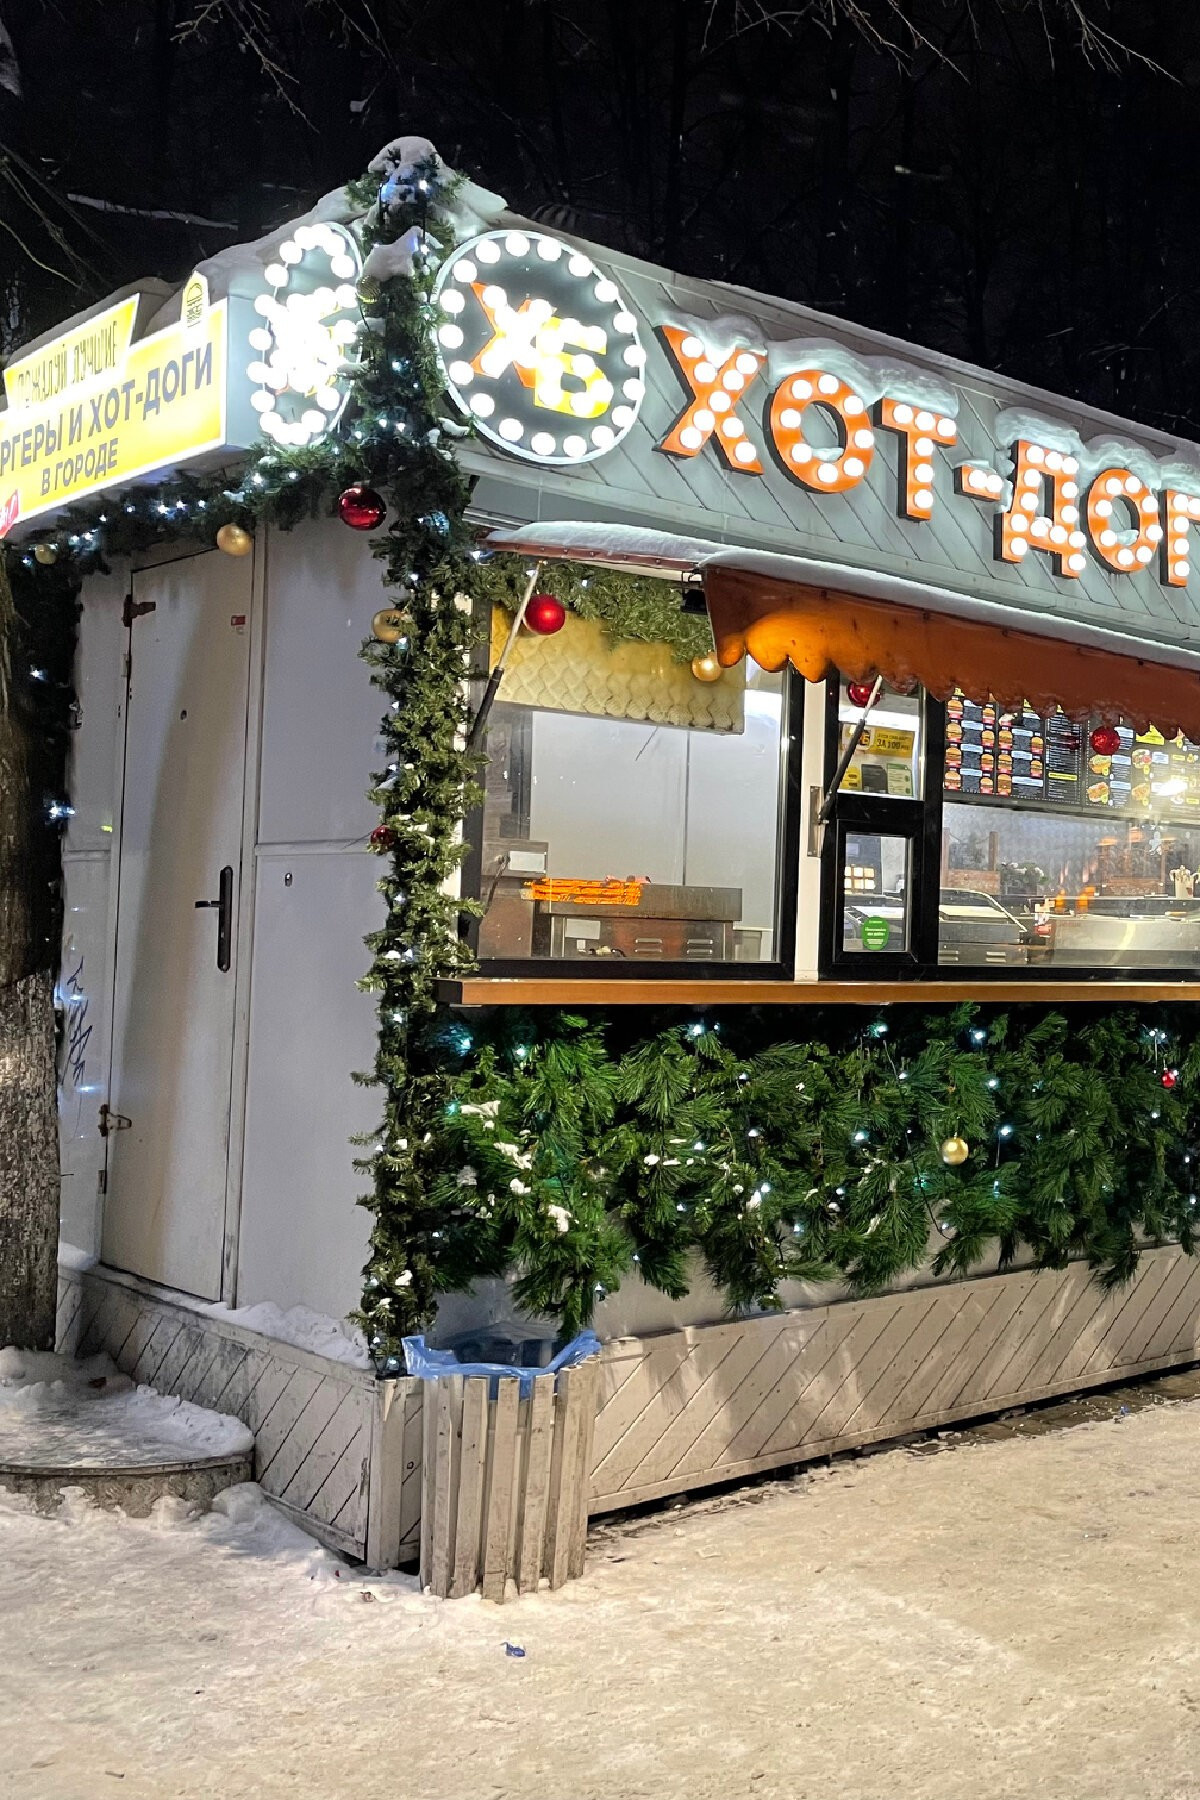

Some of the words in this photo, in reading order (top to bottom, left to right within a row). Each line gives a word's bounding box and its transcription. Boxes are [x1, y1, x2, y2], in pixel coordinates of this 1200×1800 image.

[68, 404, 83, 446] И
[87, 342, 213, 438] ХОТ-ДОГИ
[41, 467, 51, 496] В
[54, 437, 119, 491] ГОРОДЕ
